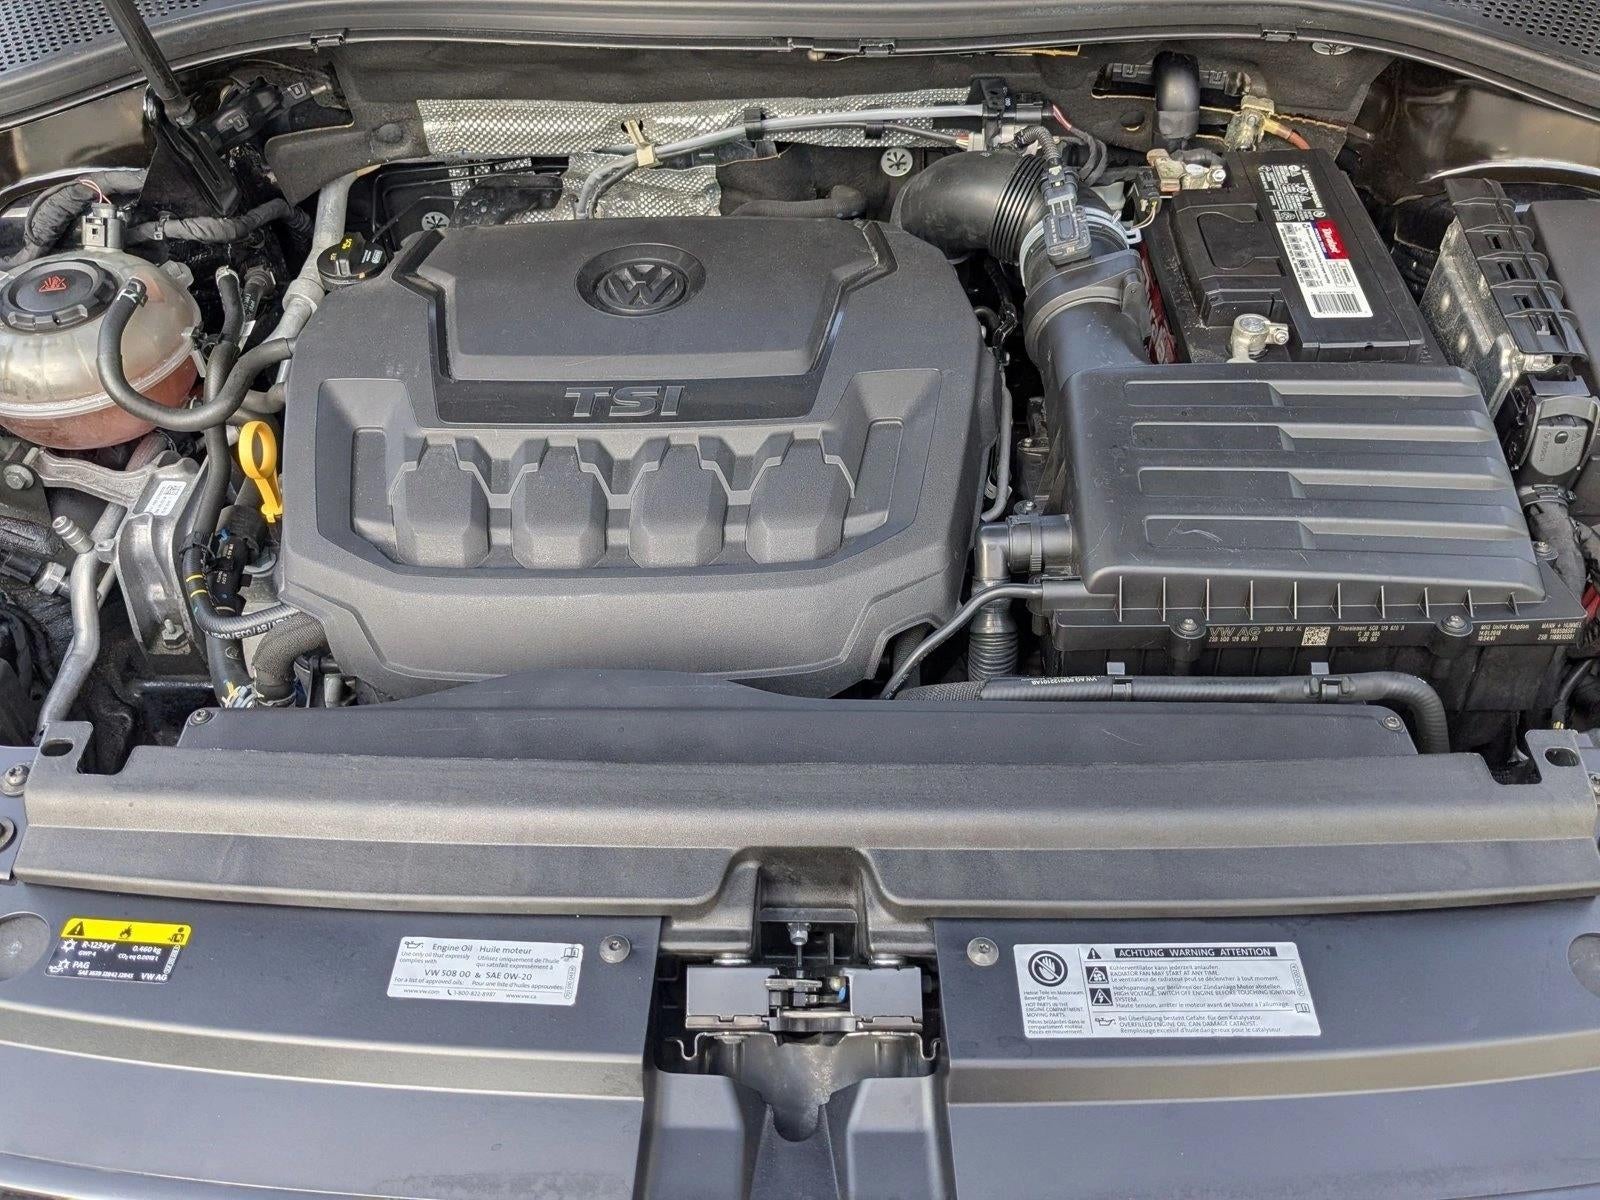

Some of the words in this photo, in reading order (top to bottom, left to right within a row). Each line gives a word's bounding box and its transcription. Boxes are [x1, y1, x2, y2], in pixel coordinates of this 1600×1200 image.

[602, 261, 682, 308] VW
[565, 385, 685, 417] TSI
[1210, 626, 1236, 636] VW
[1237, 626, 1260, 636] AG
[82, 941, 116, 951] R-1234yf
[153, 946, 162, 955] kg
[432, 944, 459, 952] Engine
[1120, 949, 1164, 957] ACHTUNG
[1169, 948, 1215, 957] WARNING
[1220, 948, 1270, 956] ATTENTION
